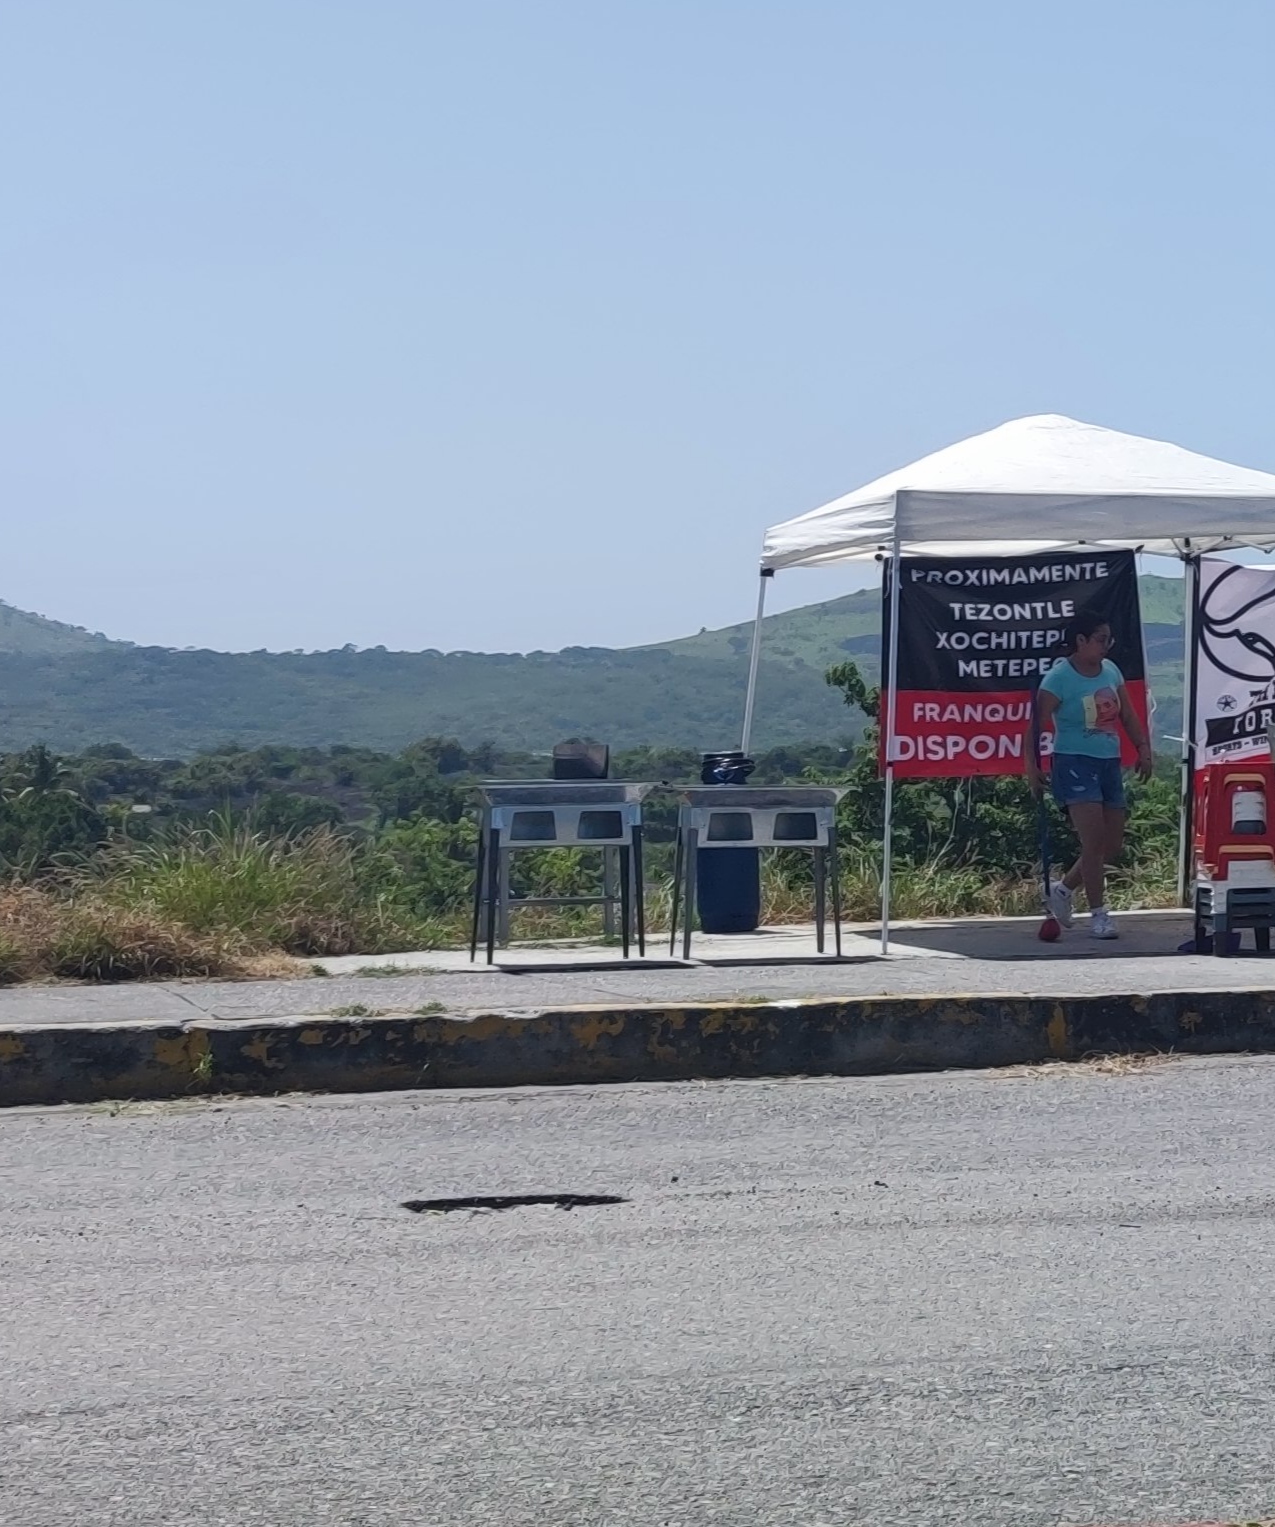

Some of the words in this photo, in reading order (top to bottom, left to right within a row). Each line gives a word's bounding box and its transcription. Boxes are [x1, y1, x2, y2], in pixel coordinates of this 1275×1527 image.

[911, 562, 1109, 586] PROXIMAMENTE
[950, 600, 1075, 620] TEZONTLE
[936, 630, 1067, 650] XOCHITEP
[913, 702, 1032, 723] FRANQUI
[893, 731, 1053, 761] DISPONB
